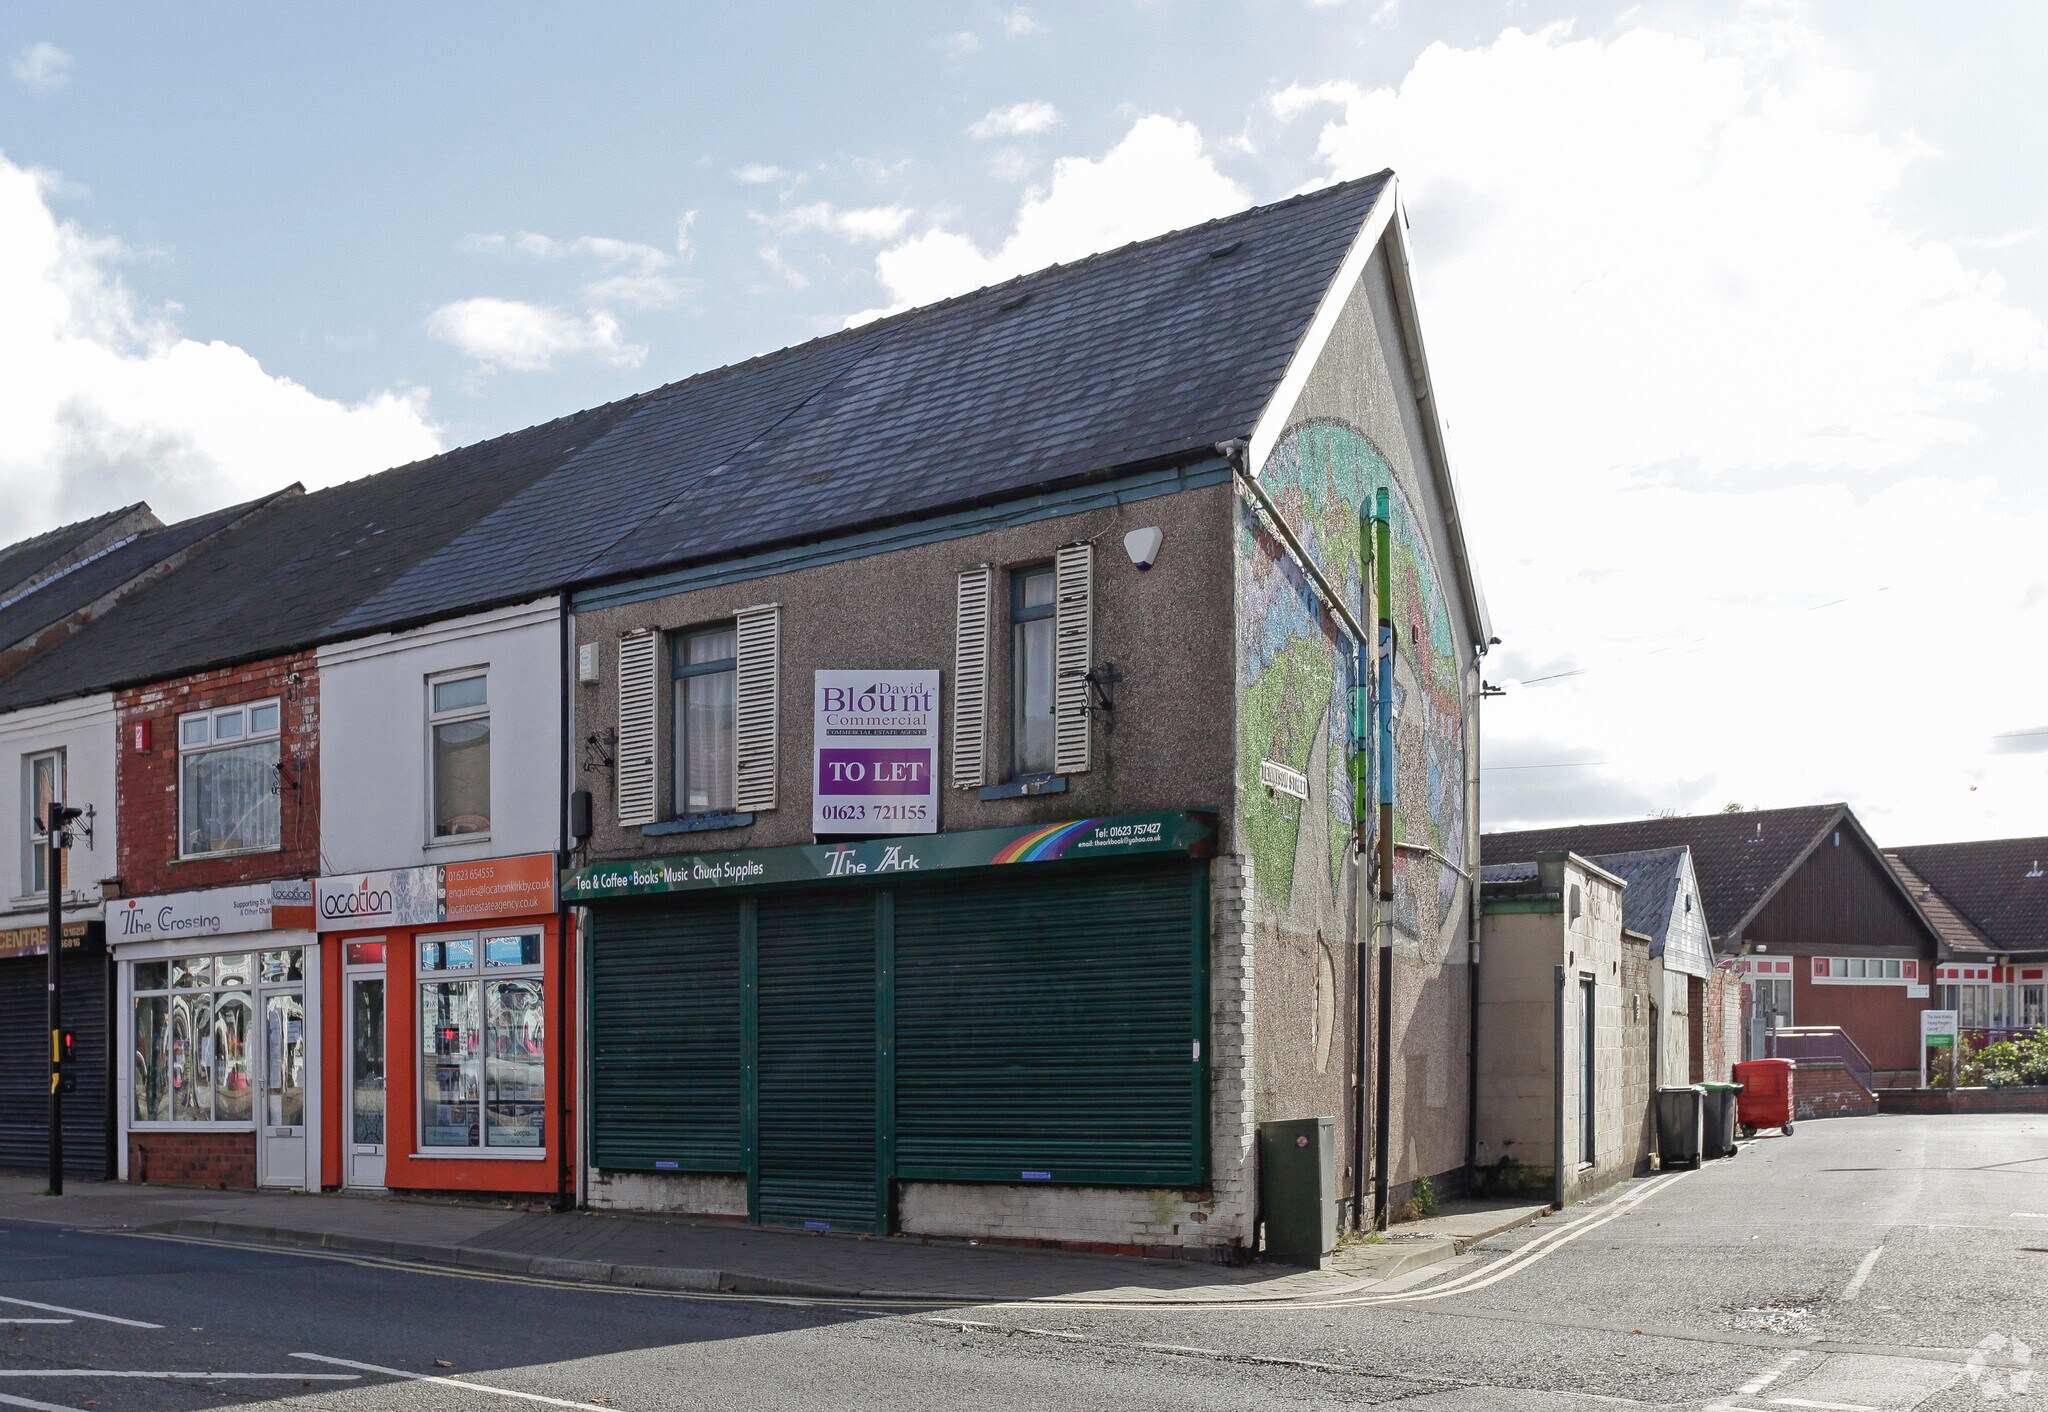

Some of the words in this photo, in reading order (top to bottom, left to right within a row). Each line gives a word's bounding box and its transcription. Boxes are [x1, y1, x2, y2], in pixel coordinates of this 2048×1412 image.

[879, 682, 924, 695] David
[822, 686, 933, 713] Blount
[826, 713, 927, 726] Commercial
[829, 762, 866, 782] TO
[872, 762, 924, 782] LET
[822, 804, 866, 820] 01623
[873, 804, 927, 820] 721155
[1094, 827, 1108, 838] Tel:
[1109, 825, 1132, 837] 01623
[1133, 822, 1161, 835] 757427
[824, 849, 867, 876] The
[874, 845, 920, 873] Ark
[448, 869, 469, 882] 01623
[469, 867, 495, 880] 654555
[576, 876, 592, 891] Tea
[592, 875, 600, 888] &
[600, 872, 628, 888] Coffee
[633, 870, 659, 885] Books
[663, 867, 688, 883] Music
[693, 862, 722, 880] Church
[724, 860, 764, 882] Supplies
[448, 878, 551, 899] enquiries@locationkirkby.co.uk
[233, 899, 259, 909] Supporting
[448, 896, 539, 915] locationestateagency.co.uk
[119, 907, 153, 936] The
[157, 905, 221, 933] Crossing
[0, 927, 47, 950] CENTRE
[63, 926, 86, 938] 01623
